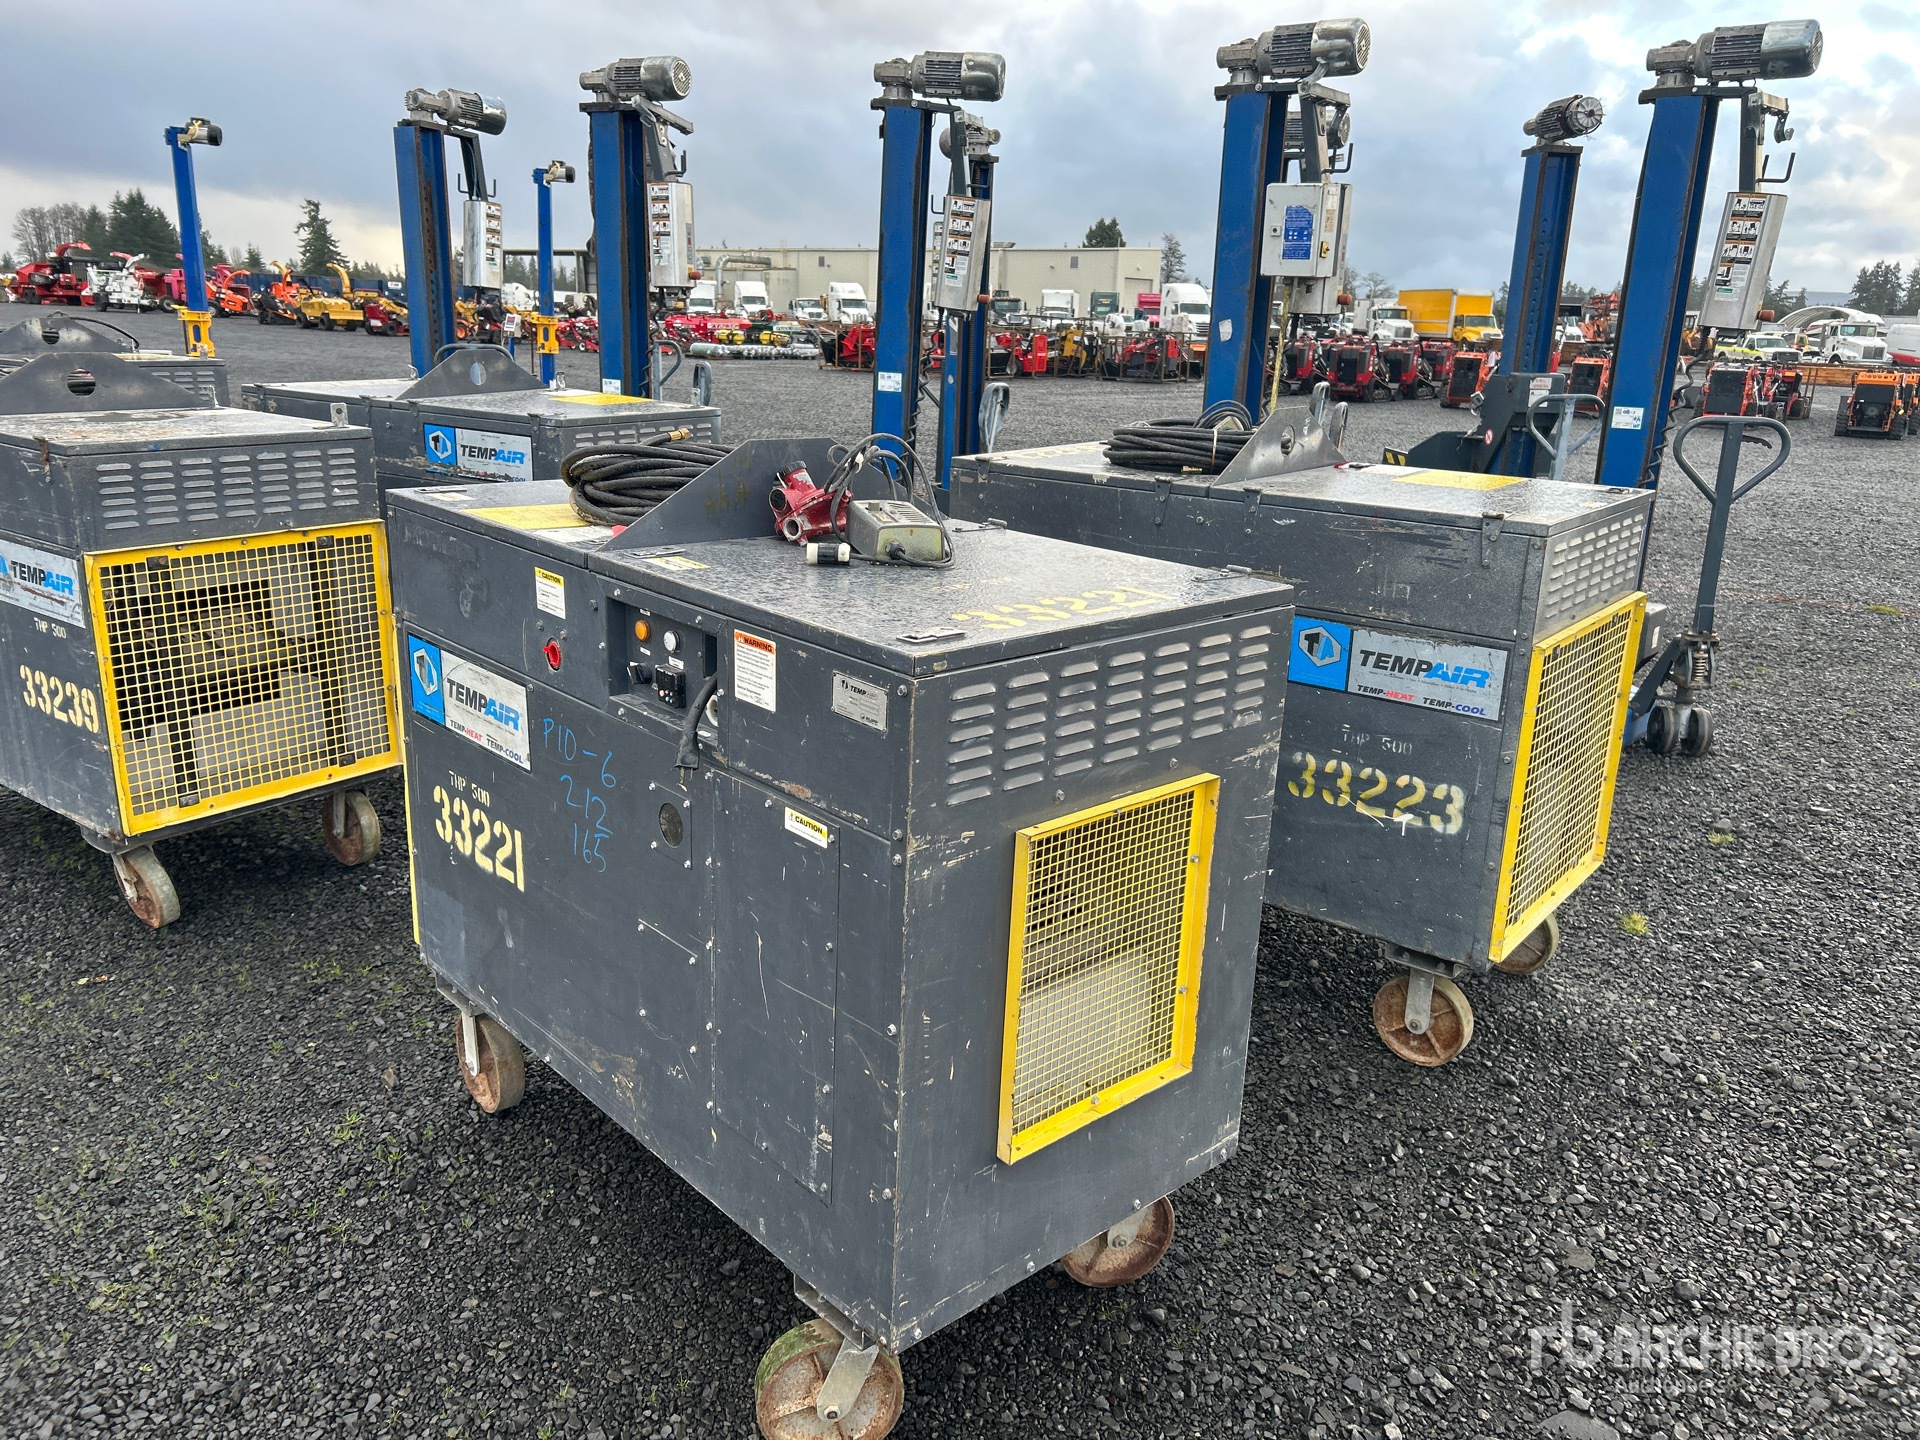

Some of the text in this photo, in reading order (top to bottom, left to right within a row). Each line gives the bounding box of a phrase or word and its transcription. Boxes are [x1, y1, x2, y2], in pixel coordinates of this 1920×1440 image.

[460, 443, 528, 465] TEMPAIR
[10, 559, 74, 596] TEMPAIR
[541, 572, 562, 584] CAUTION
[951, 585, 1179, 630] 33221
[51, 623, 67, 639] 500
[743, 638, 773, 652] WARNING
[1359, 649, 1492, 689] TEMPAIR
[19, 664, 99, 734] 33239
[446, 678, 523, 731] TEMPAIR
[1357, 684, 1487, 716] TEMP-HEAT TEMP-COOL
[449, 719, 483, 742] TEMP-HEAT
[486, 737, 524, 764] TEMP-COOL
[1382, 737, 1413, 755] 500
[448, 770, 490, 808] THP 500
[560, 774, 614, 835] 212
[1287, 752, 1464, 835] 33223
[433, 785, 525, 893] 33221
[795, 816, 823, 835] CAUTION
[573, 822, 608, 873] 165
